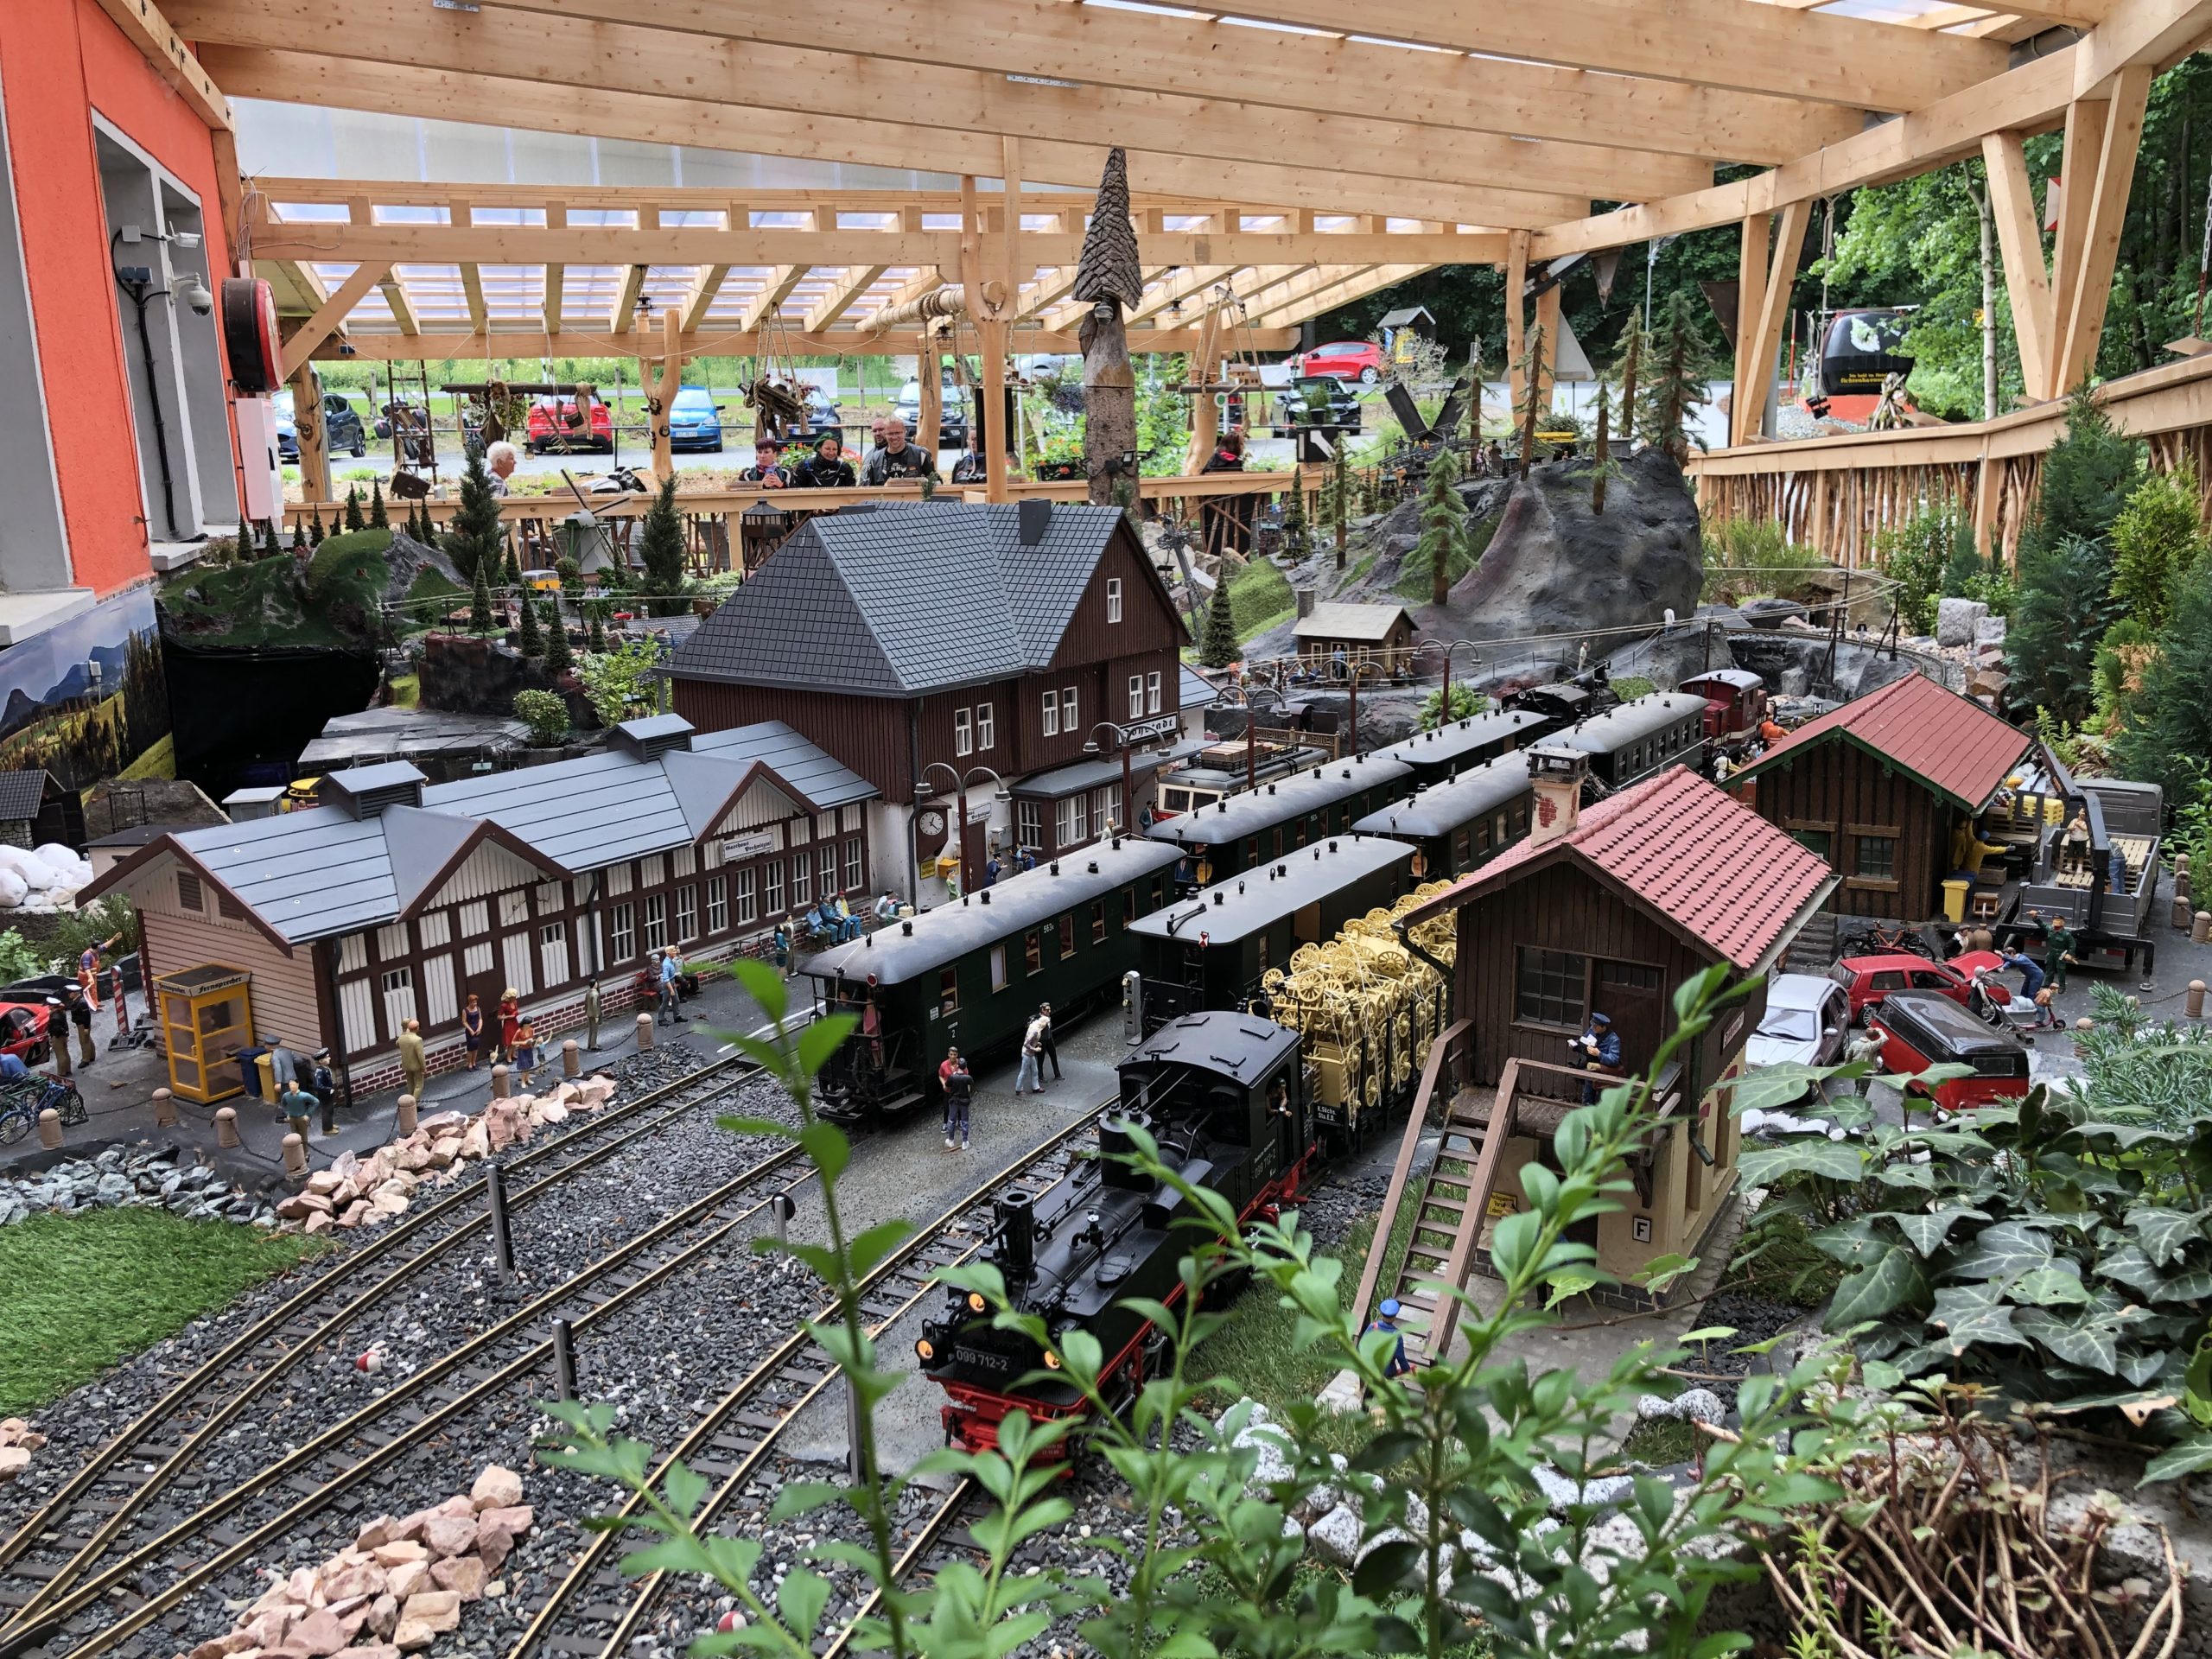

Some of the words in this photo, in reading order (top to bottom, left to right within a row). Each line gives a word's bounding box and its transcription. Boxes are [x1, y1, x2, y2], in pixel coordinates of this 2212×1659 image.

[1637, 1221, 1648, 1237] F
[956, 1350, 976, 1364] 099
[977, 1354, 1008, 1371] 712-2
